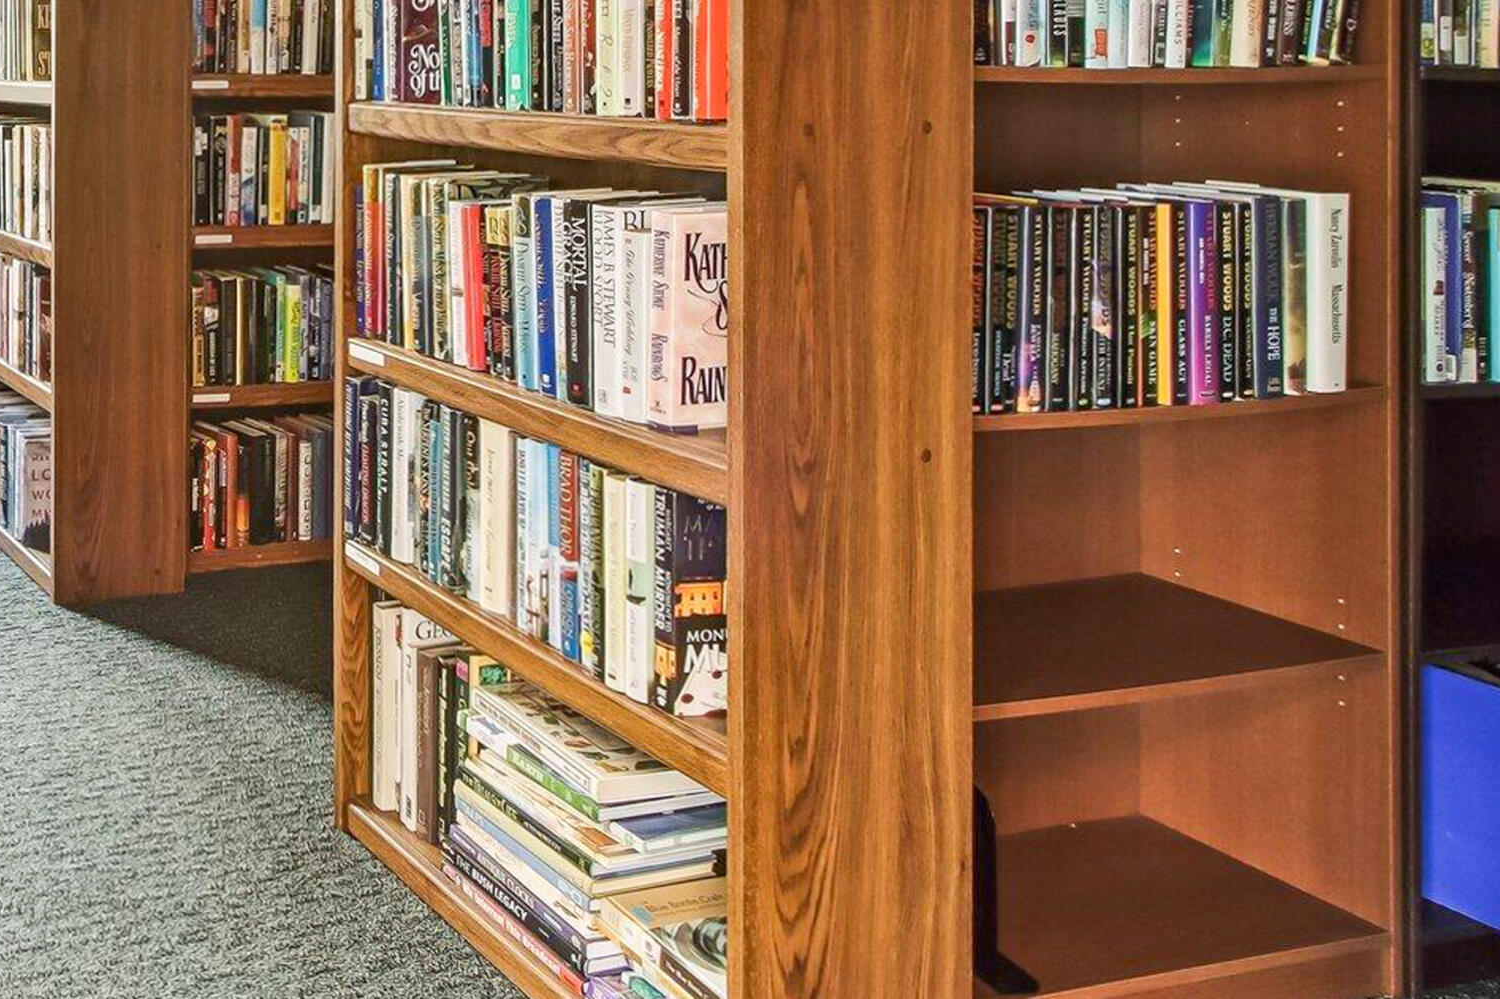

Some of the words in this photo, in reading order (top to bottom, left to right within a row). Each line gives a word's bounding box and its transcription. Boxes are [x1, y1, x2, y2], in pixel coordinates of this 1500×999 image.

[552, 16, 562, 42] STEEL
[603, 210, 615, 256] JAMES
[1007, 215, 1018, 269] STUART
[1033, 214, 1042, 263] STUART
[1083, 213, 1091, 261] STUART
[1128, 214, 1136, 262] STUART
[1177, 211, 1186, 258] STUART
[1223, 211, 1232, 259] STUART
[1329, 209, 1342, 233] Nancy
[571, 216, 587, 291] MORTAL
[1007, 276, 1017, 329] WOODS
[1033, 265, 1041, 316] WOODS
[1082, 265, 1090, 313] WOODS
[1128, 266, 1136, 316] WOODS
[1177, 262, 1186, 310] WOODS
[1222, 263, 1231, 311] WOODS
[603, 278, 616, 348] STEWART
[1204, 315, 1212, 351] BARELY
[1331, 284, 1342, 344] Massachusetts
[570, 329, 578, 363] STEWART
[1050, 332, 1059, 385] MAHOGANY
[1178, 319, 1186, 358] CLASS
[1267, 326, 1280, 361] HOPE
[1178, 361, 1186, 384] ACT
[380, 398, 389, 435] CUBA
[360, 443, 370, 480] FLOATING
[560, 455, 573, 502] BRAD
[361, 481, 370, 525] DRAGON
[580, 486, 590, 523] BRAD
[655, 493, 666, 561] TRUMAN
[441, 517, 451, 569] ESCAPE
[560, 504, 573, 555] THOR
[580, 525, 590, 566] THOR
[654, 566, 666, 630] MURDER
[469, 867, 495, 893] BUSH
[493, 886, 529, 922] LEGACY
